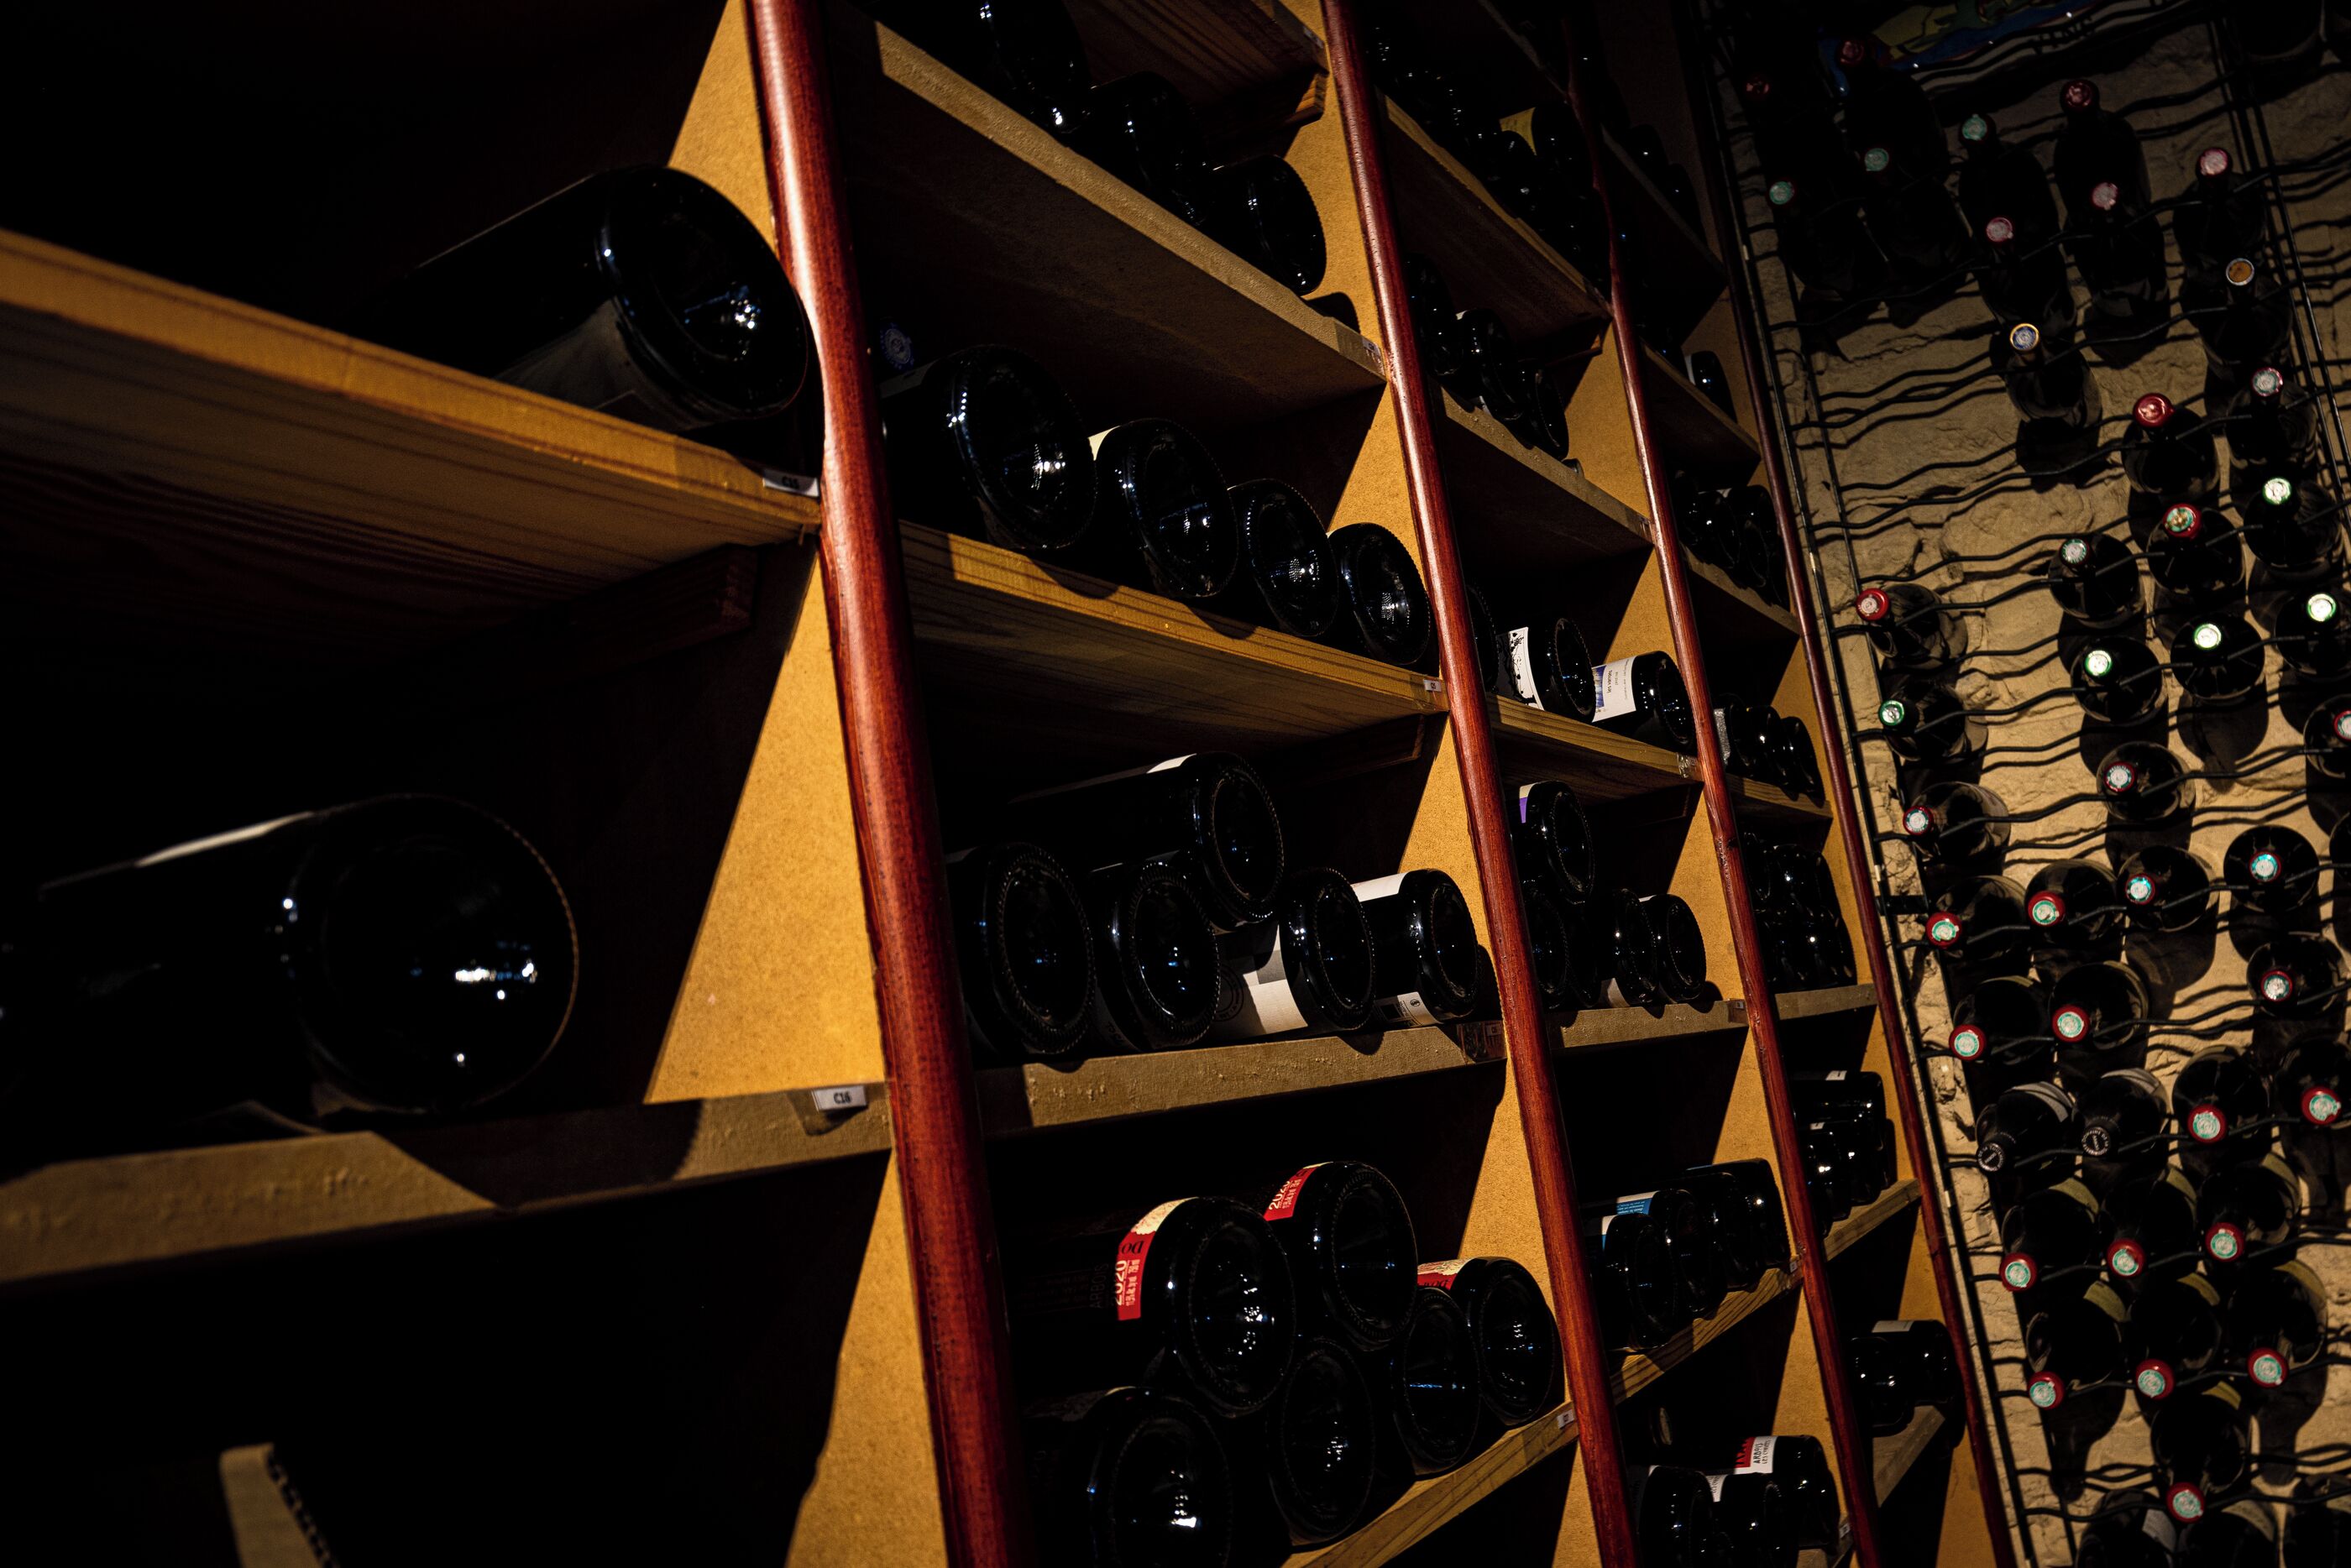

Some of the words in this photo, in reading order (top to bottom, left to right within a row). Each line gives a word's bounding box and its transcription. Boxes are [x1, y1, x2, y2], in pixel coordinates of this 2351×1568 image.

[834, 1092, 851, 1104] C16
[1110, 1260, 1128, 1307] 2020
[1753, 1443, 1764, 1464] ARBOIS
